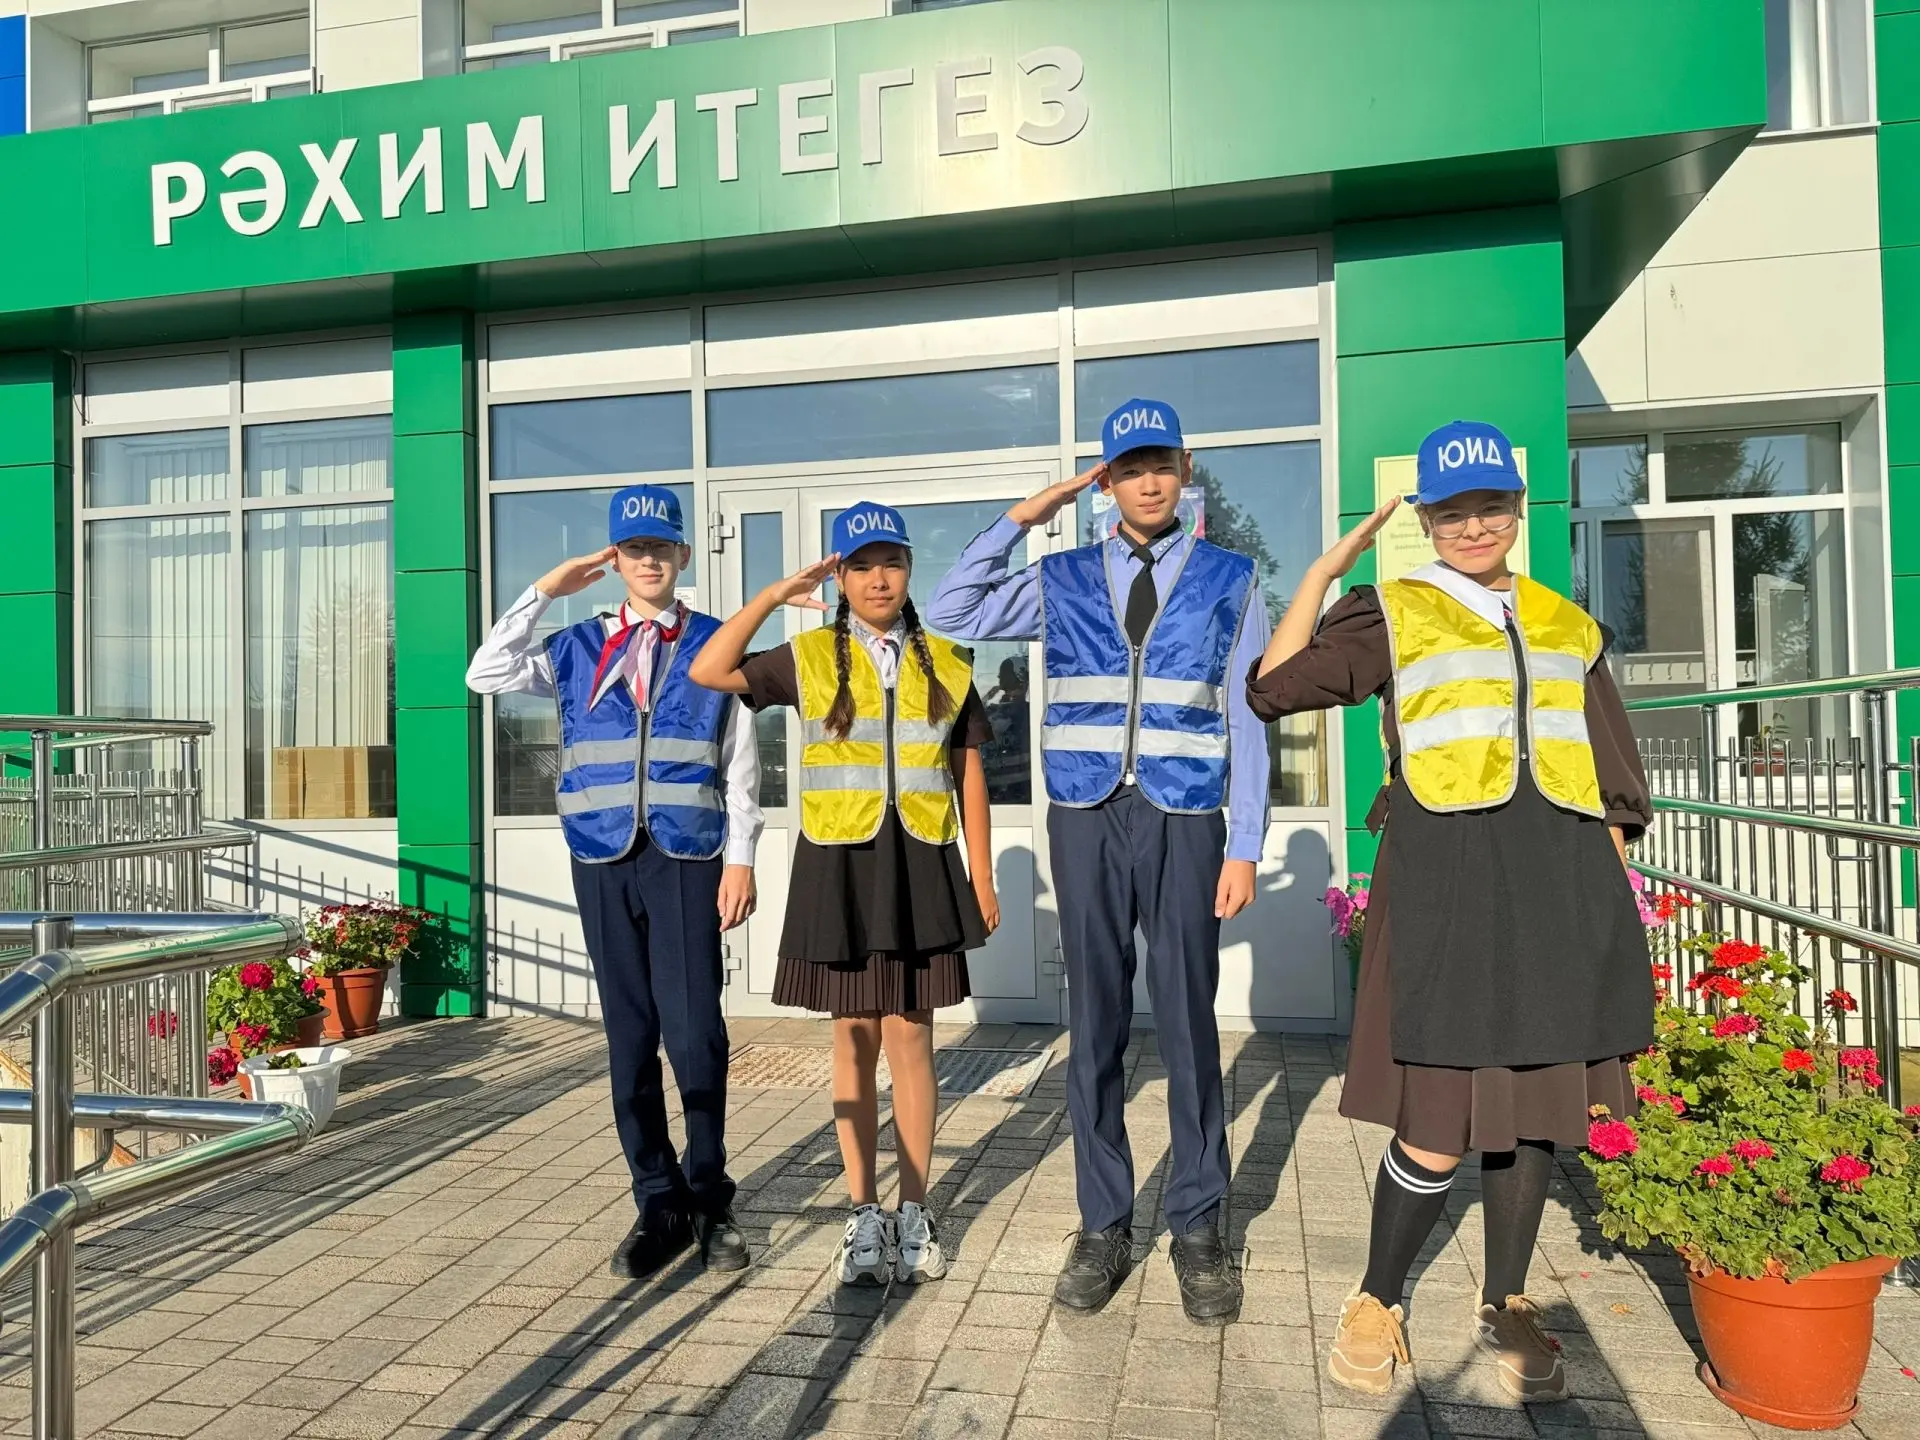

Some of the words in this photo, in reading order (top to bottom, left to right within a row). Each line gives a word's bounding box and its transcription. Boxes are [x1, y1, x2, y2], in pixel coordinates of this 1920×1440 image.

[151, 115, 546, 246] РӘХИМ
[608, 46, 1089, 193] ИТЕГЕЗ
[1112, 408, 1166, 440] ЮИД
[1437, 437, 1504, 472] ЮИД
[621, 495, 669, 522] ЮИД
[846, 511, 897, 538] ЮИД
